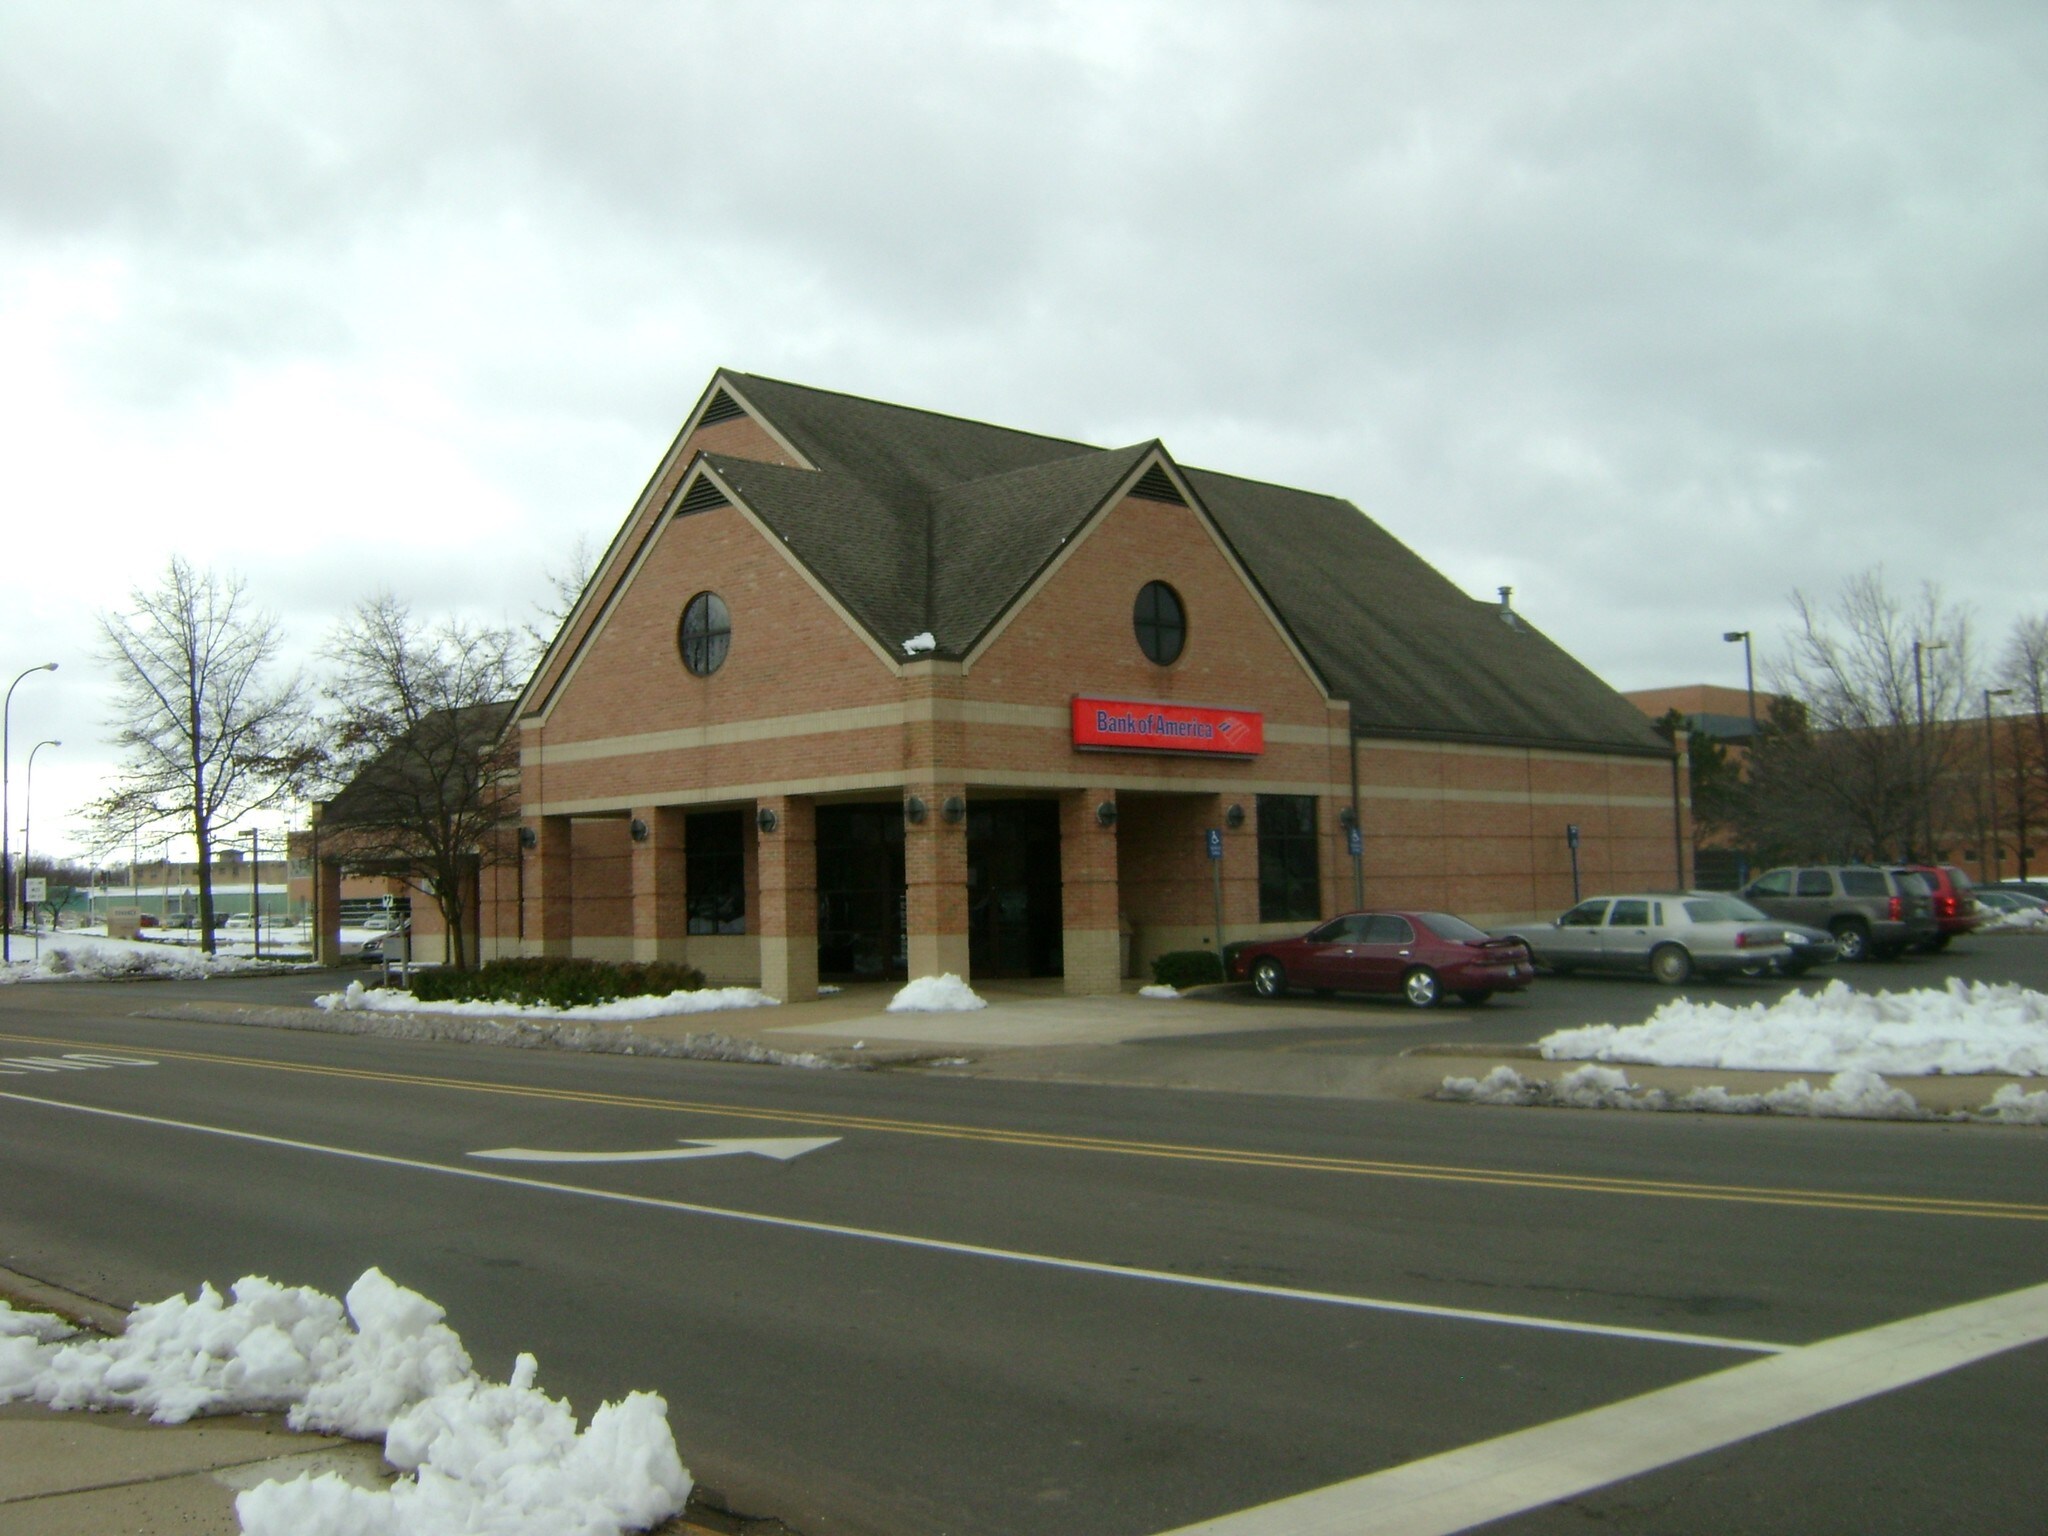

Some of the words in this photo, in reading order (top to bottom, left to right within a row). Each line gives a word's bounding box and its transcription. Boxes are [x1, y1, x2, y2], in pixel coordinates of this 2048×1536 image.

[1096, 710, 1136, 733] Bank
[1138, 714, 1154, 734] of
[1155, 714, 1213, 738] America
